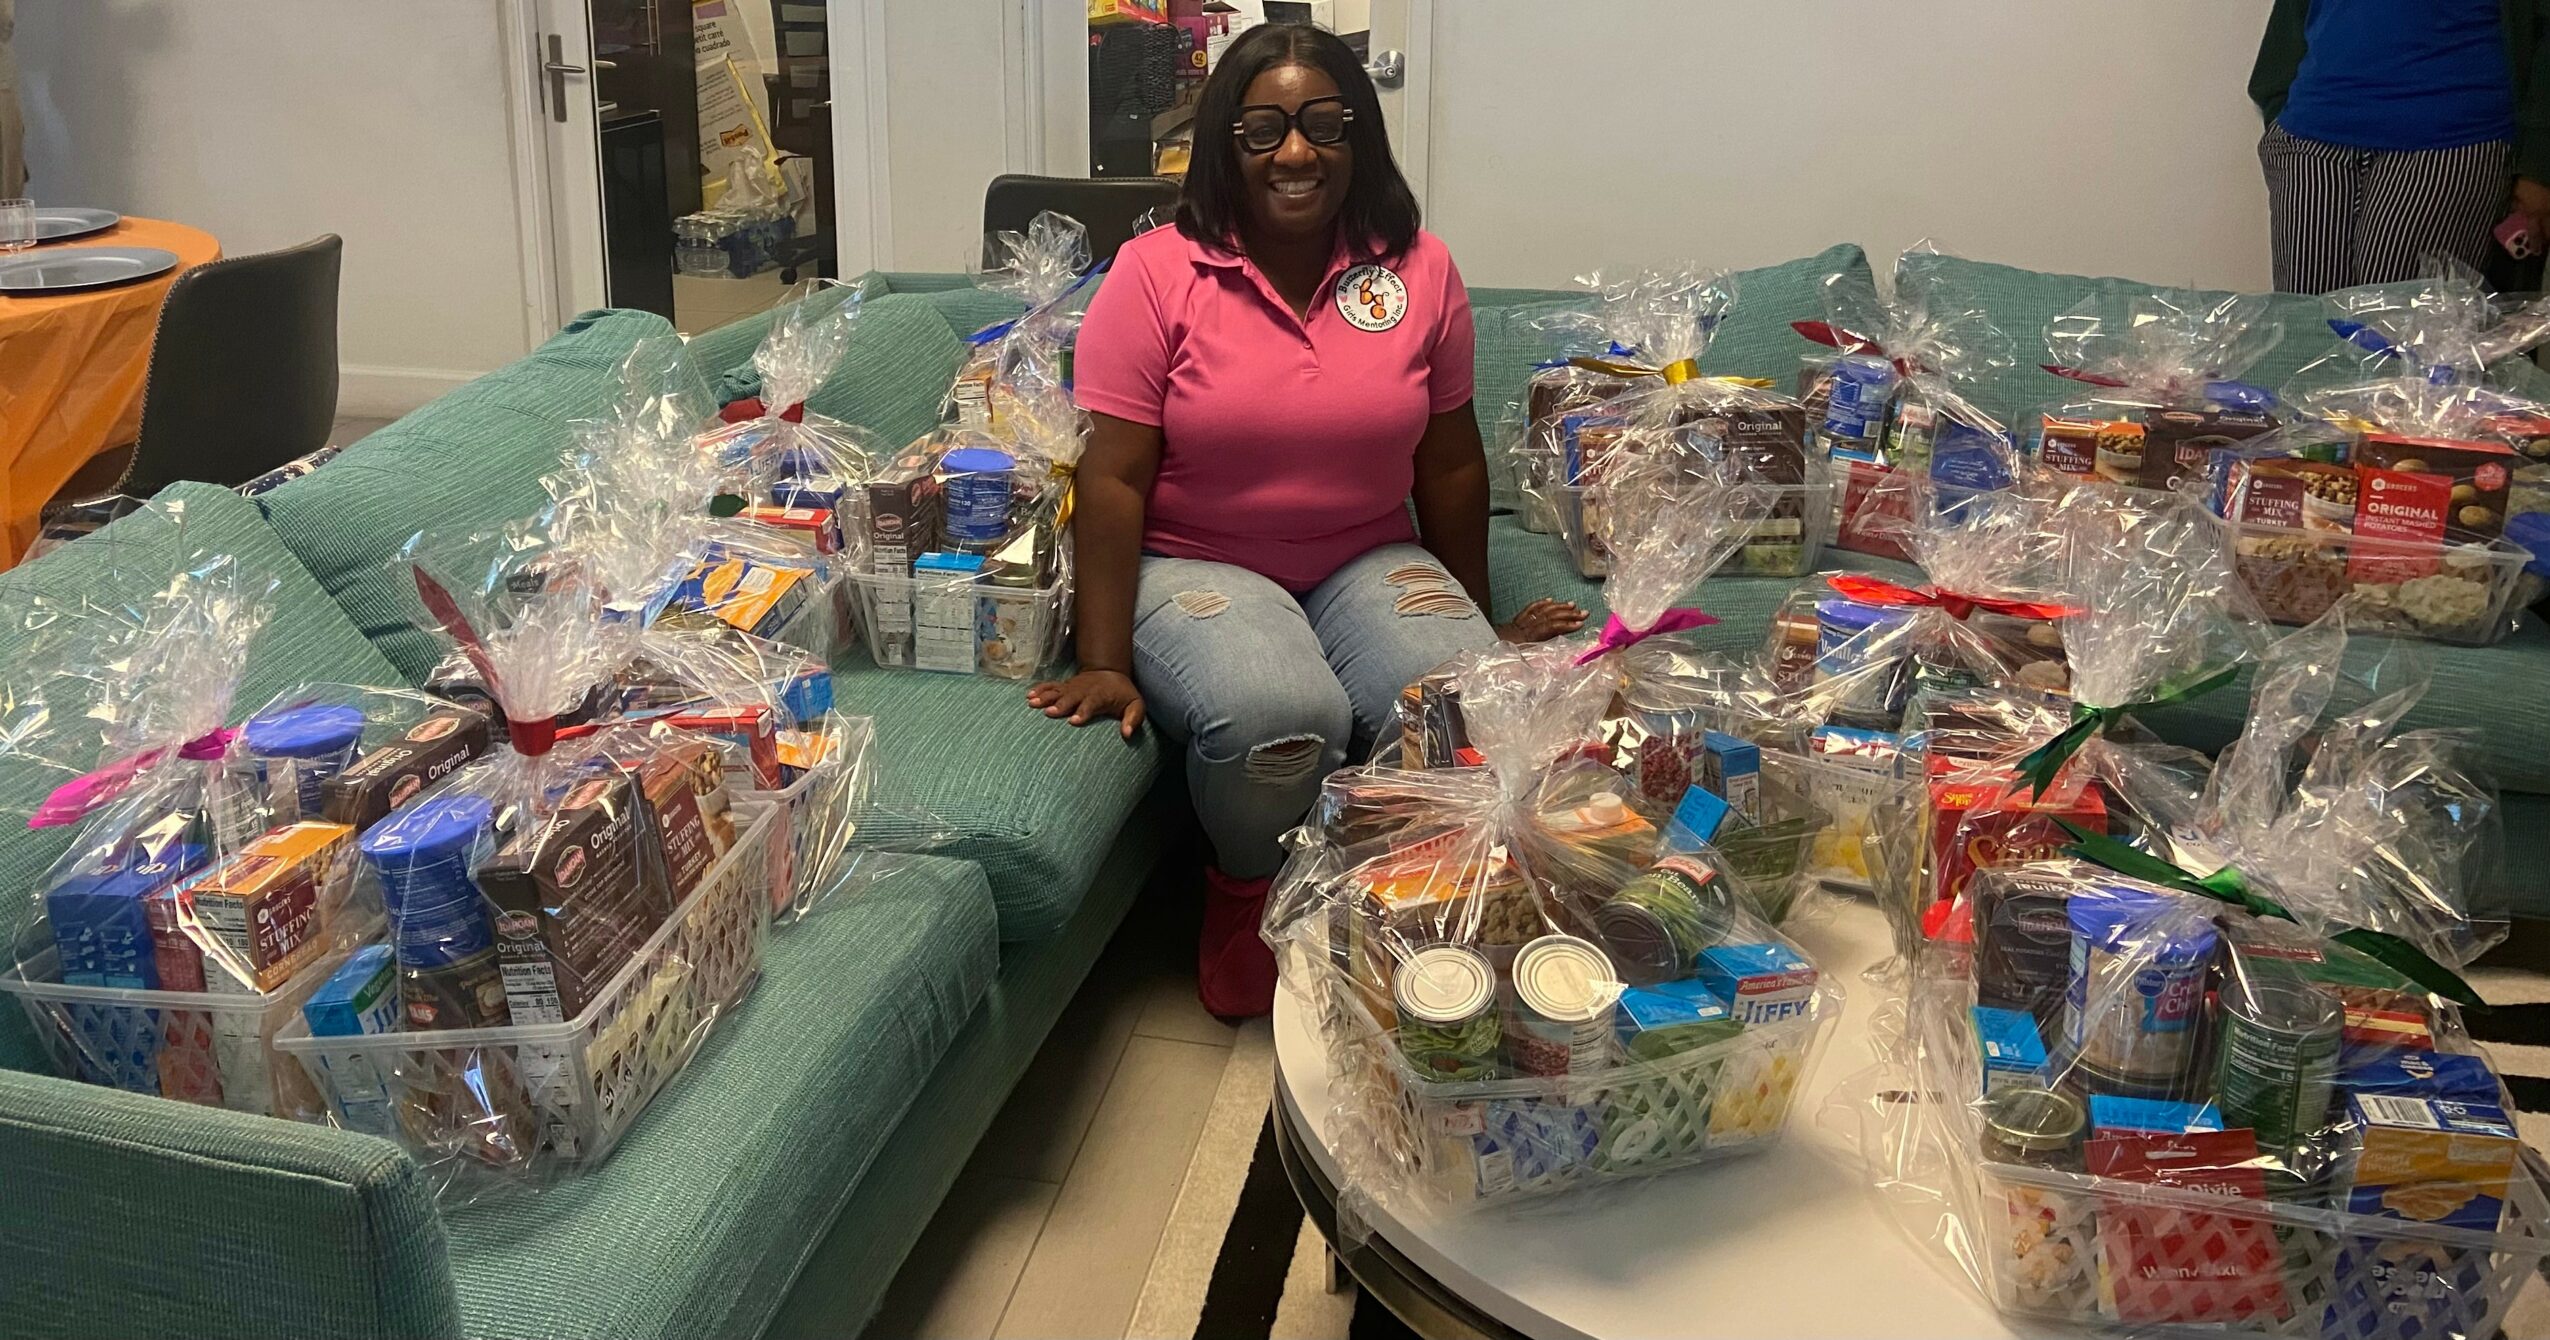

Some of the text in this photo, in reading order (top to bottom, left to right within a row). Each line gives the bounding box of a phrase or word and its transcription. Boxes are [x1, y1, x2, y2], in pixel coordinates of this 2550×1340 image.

[1338, 267, 1403, 294] Butterfly Effect
[1343, 304, 1403, 328] Girls Mentoring Inc
[1737, 421, 1782, 432] Original
[2045, 454, 2092, 465] STUFFING
[2060, 463, 2077, 471] MIX
[2249, 497, 2299, 510] STUFFING
[2263, 507, 2283, 517] MIX
[2367, 502, 2438, 520] ORIGINAL
[2256, 518, 2288, 527] TURKEY
[2363, 522, 2408, 533] POTATOES
[2365, 515, 2437, 529] INSTANT MASHED
[873, 532, 904, 541] Original
[428, 744, 470, 780] Original
[591, 806, 630, 849] Original
[667, 814, 700, 854] STUFFING
[681, 837, 695, 858] MIX
[681, 850, 701, 874] TURKEY
[279, 932, 302, 956] MIX
[497, 941, 546, 955] Original
[502, 964, 552, 977] Nutrition Facts
[1744, 996, 1811, 1024] JIFFY
[2233, 1026, 2297, 1053] Nutrition Facts
[2230, 1055, 2294, 1081] Calories 15
[2188, 1181, 2242, 1197] Dixie
